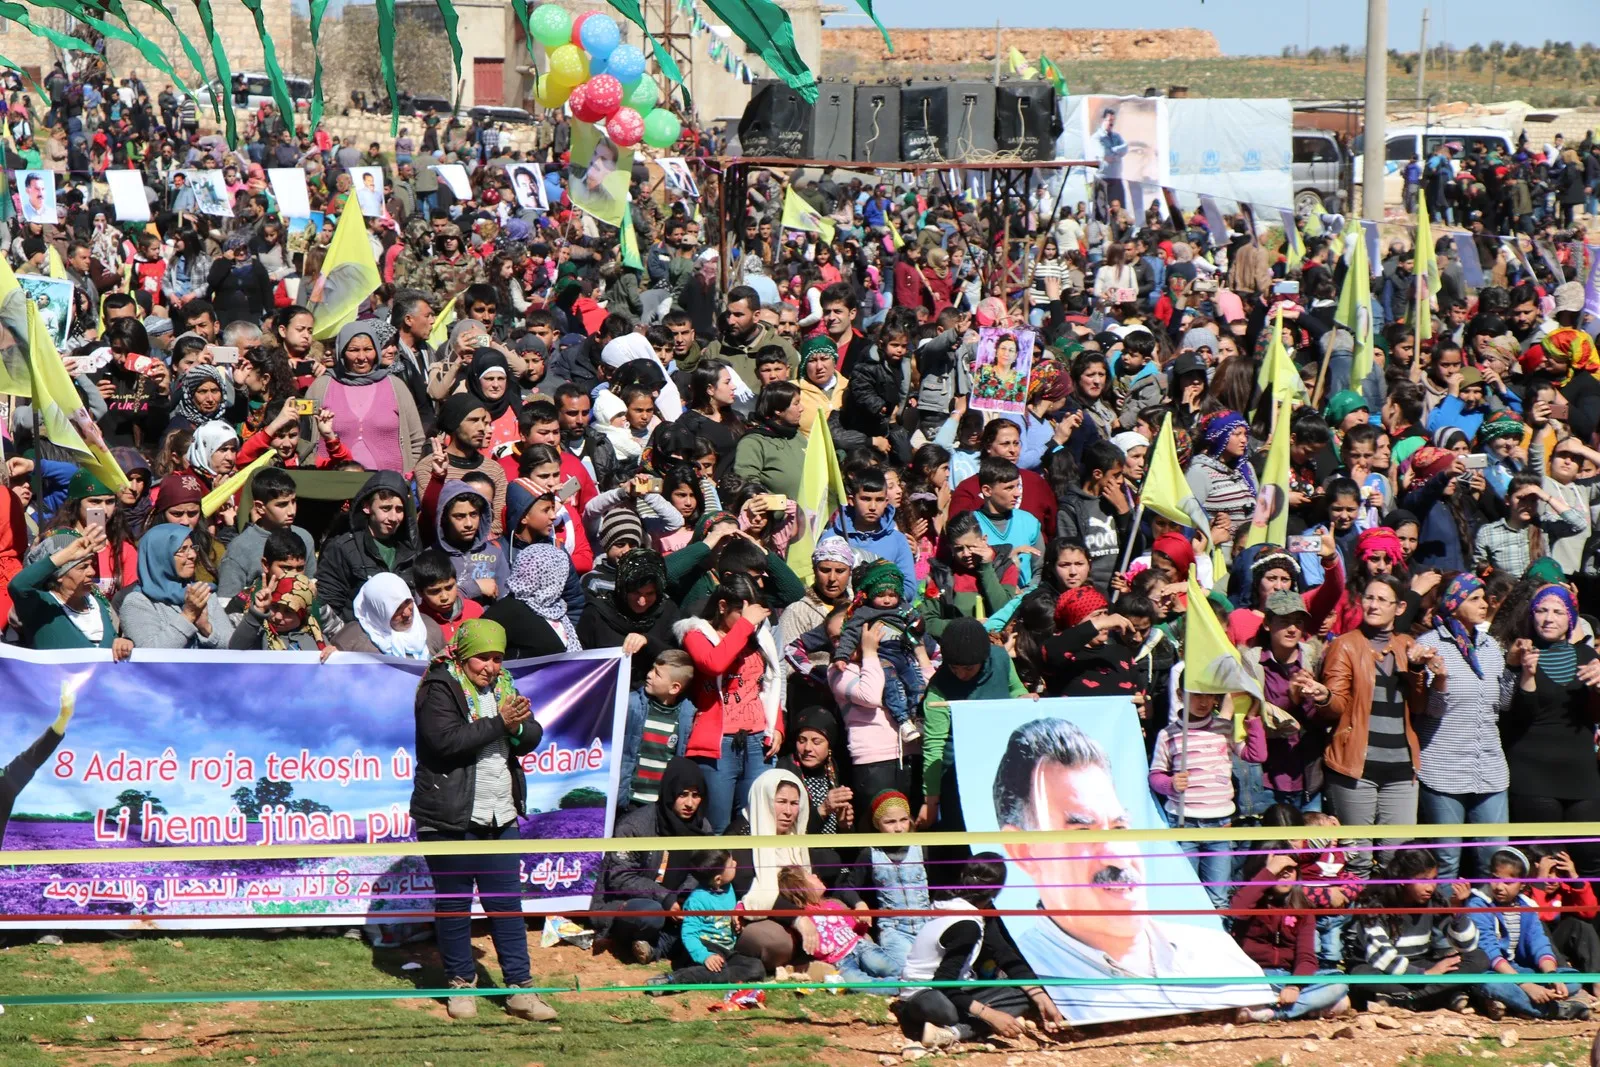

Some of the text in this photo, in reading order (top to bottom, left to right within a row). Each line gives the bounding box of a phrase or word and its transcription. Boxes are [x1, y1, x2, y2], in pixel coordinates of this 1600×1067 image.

[471, 553, 496, 563] aero
[55, 740, 602, 787] 8 Adarê roja tekoşîn û edanê
[96, 808, 128, 840] Li
[143, 803, 245, 841] hemû
[257, 807, 351, 845] jinan
[334, 869, 350, 895] 8
[533, 861, 580, 888] نبارك
